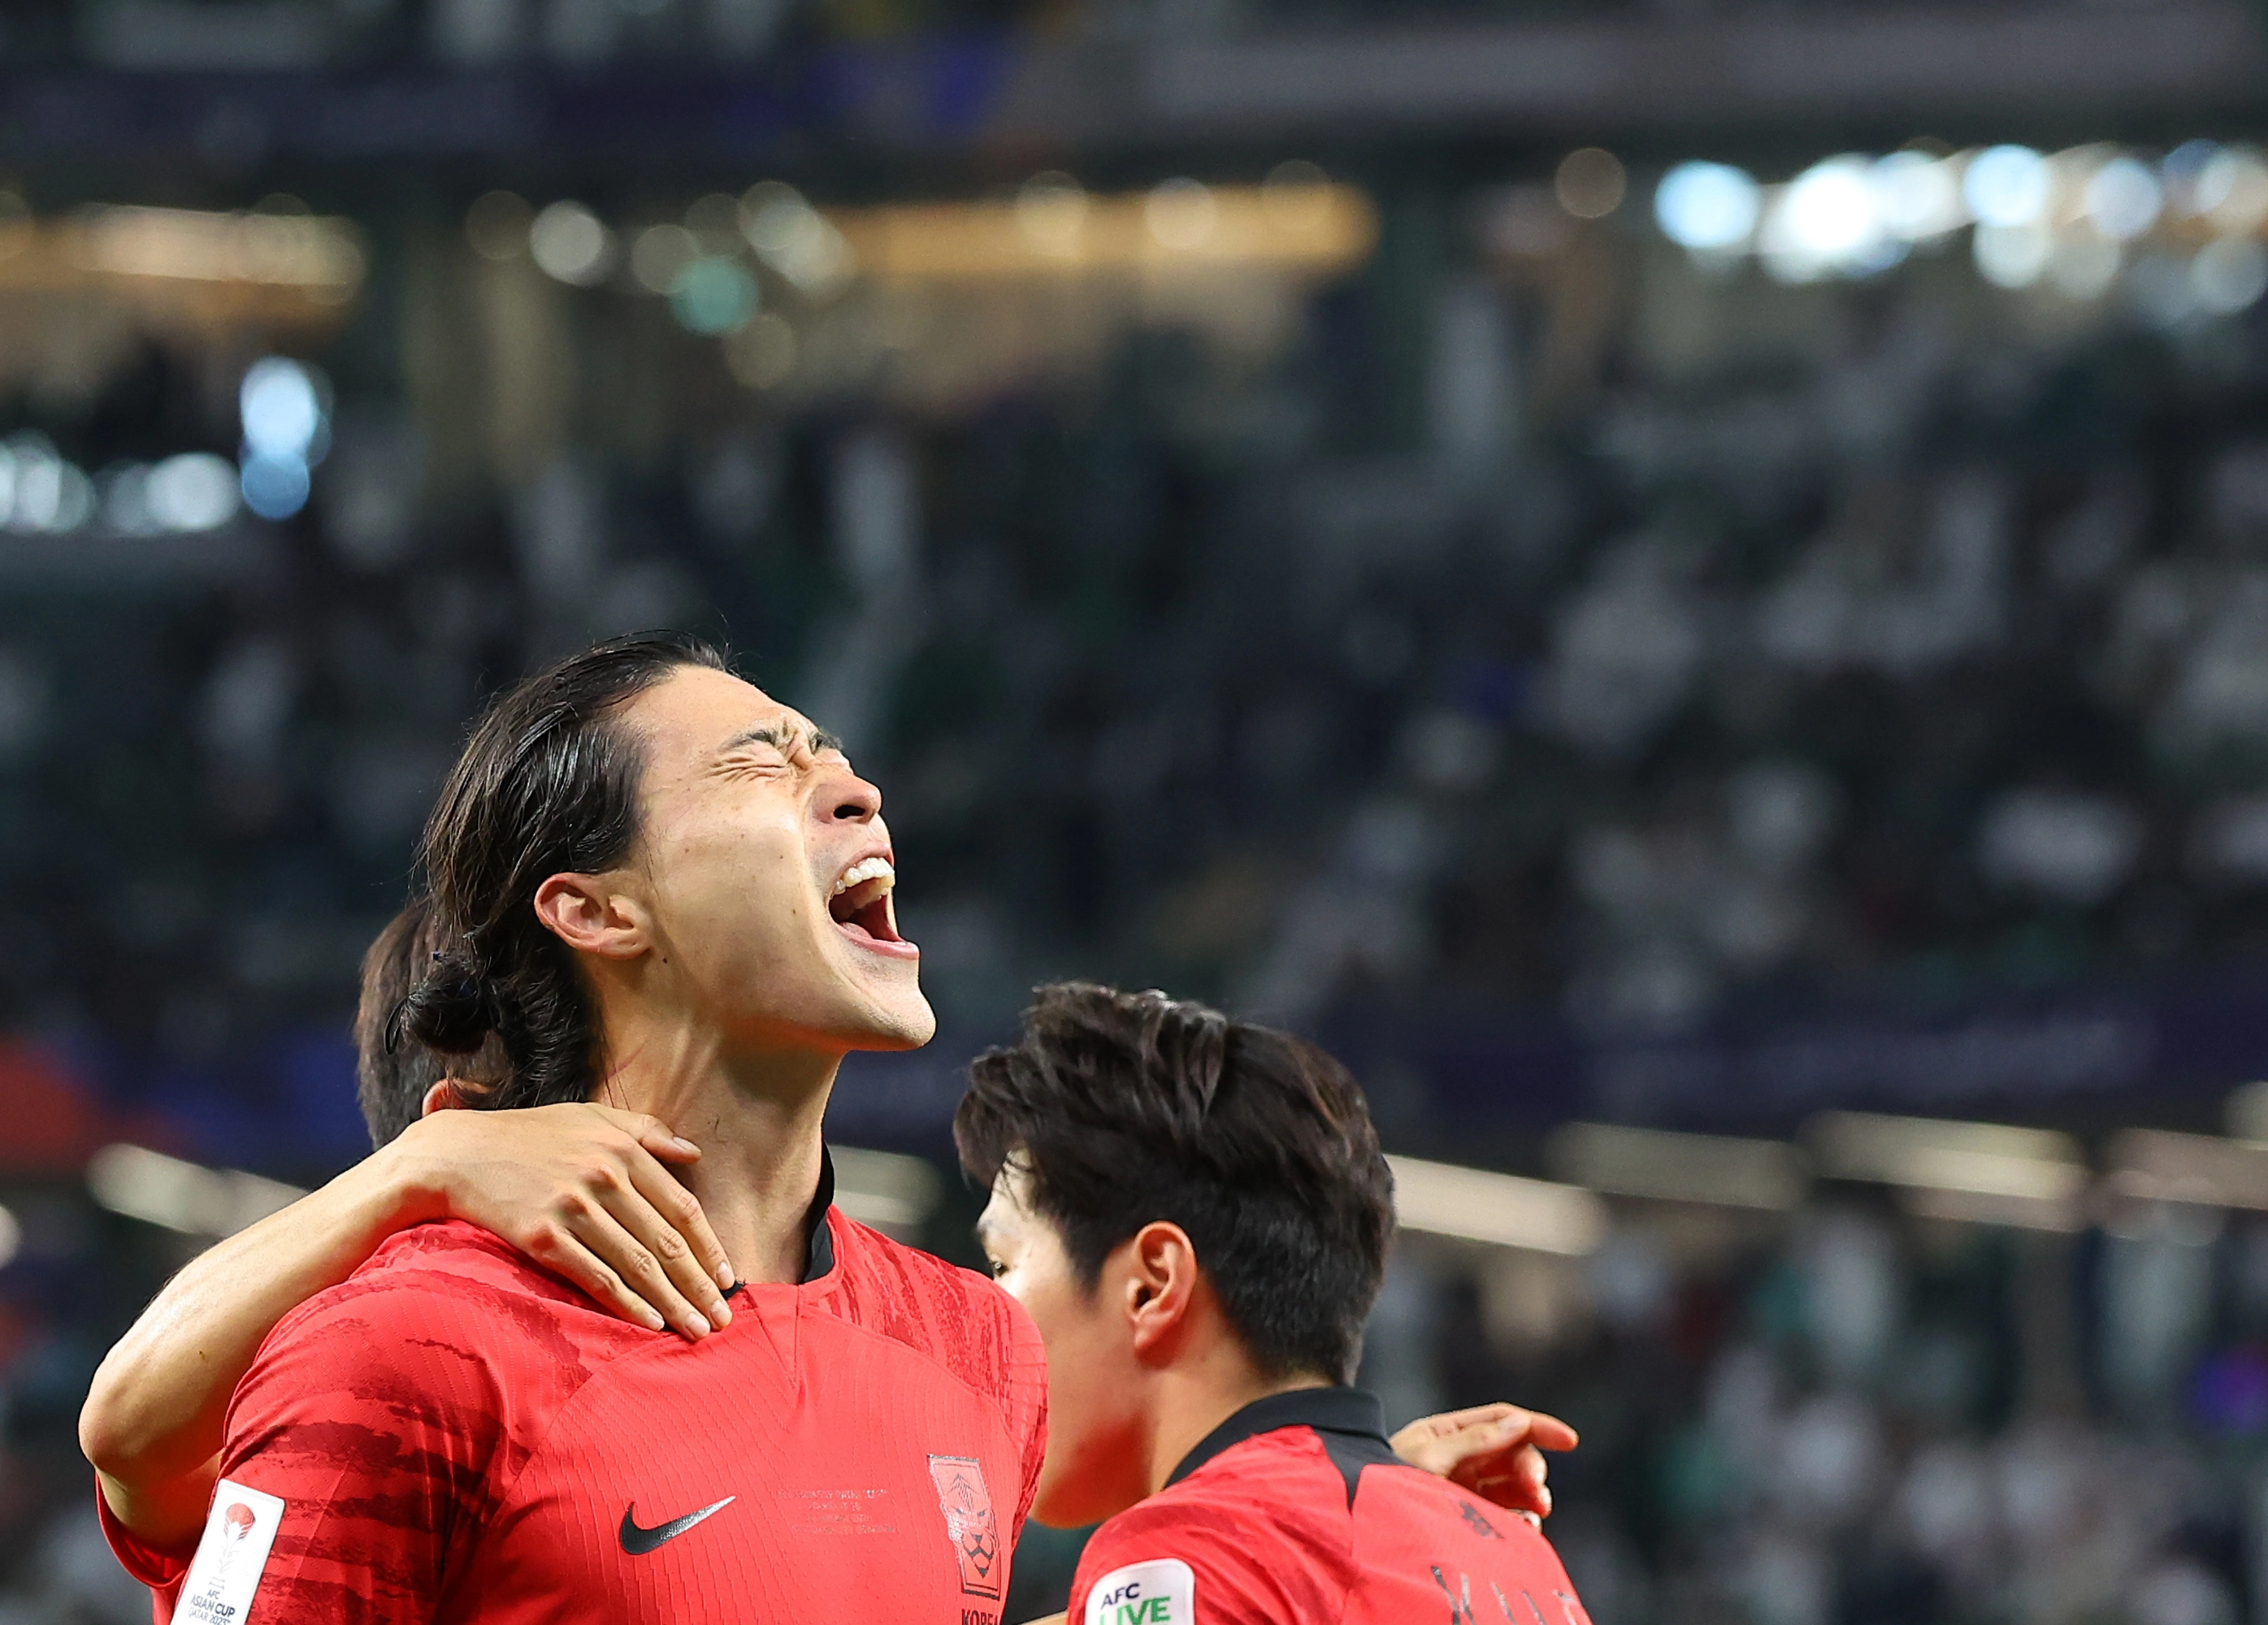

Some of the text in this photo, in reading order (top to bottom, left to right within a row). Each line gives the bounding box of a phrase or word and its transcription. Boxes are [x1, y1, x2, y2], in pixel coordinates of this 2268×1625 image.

[206, 1589, 220, 1600] AFC
[1101, 1583, 1139, 1610] AFC
[189, 1594, 236, 1618] ASIAN CUP
[189, 1607, 208, 1622] QATAR
